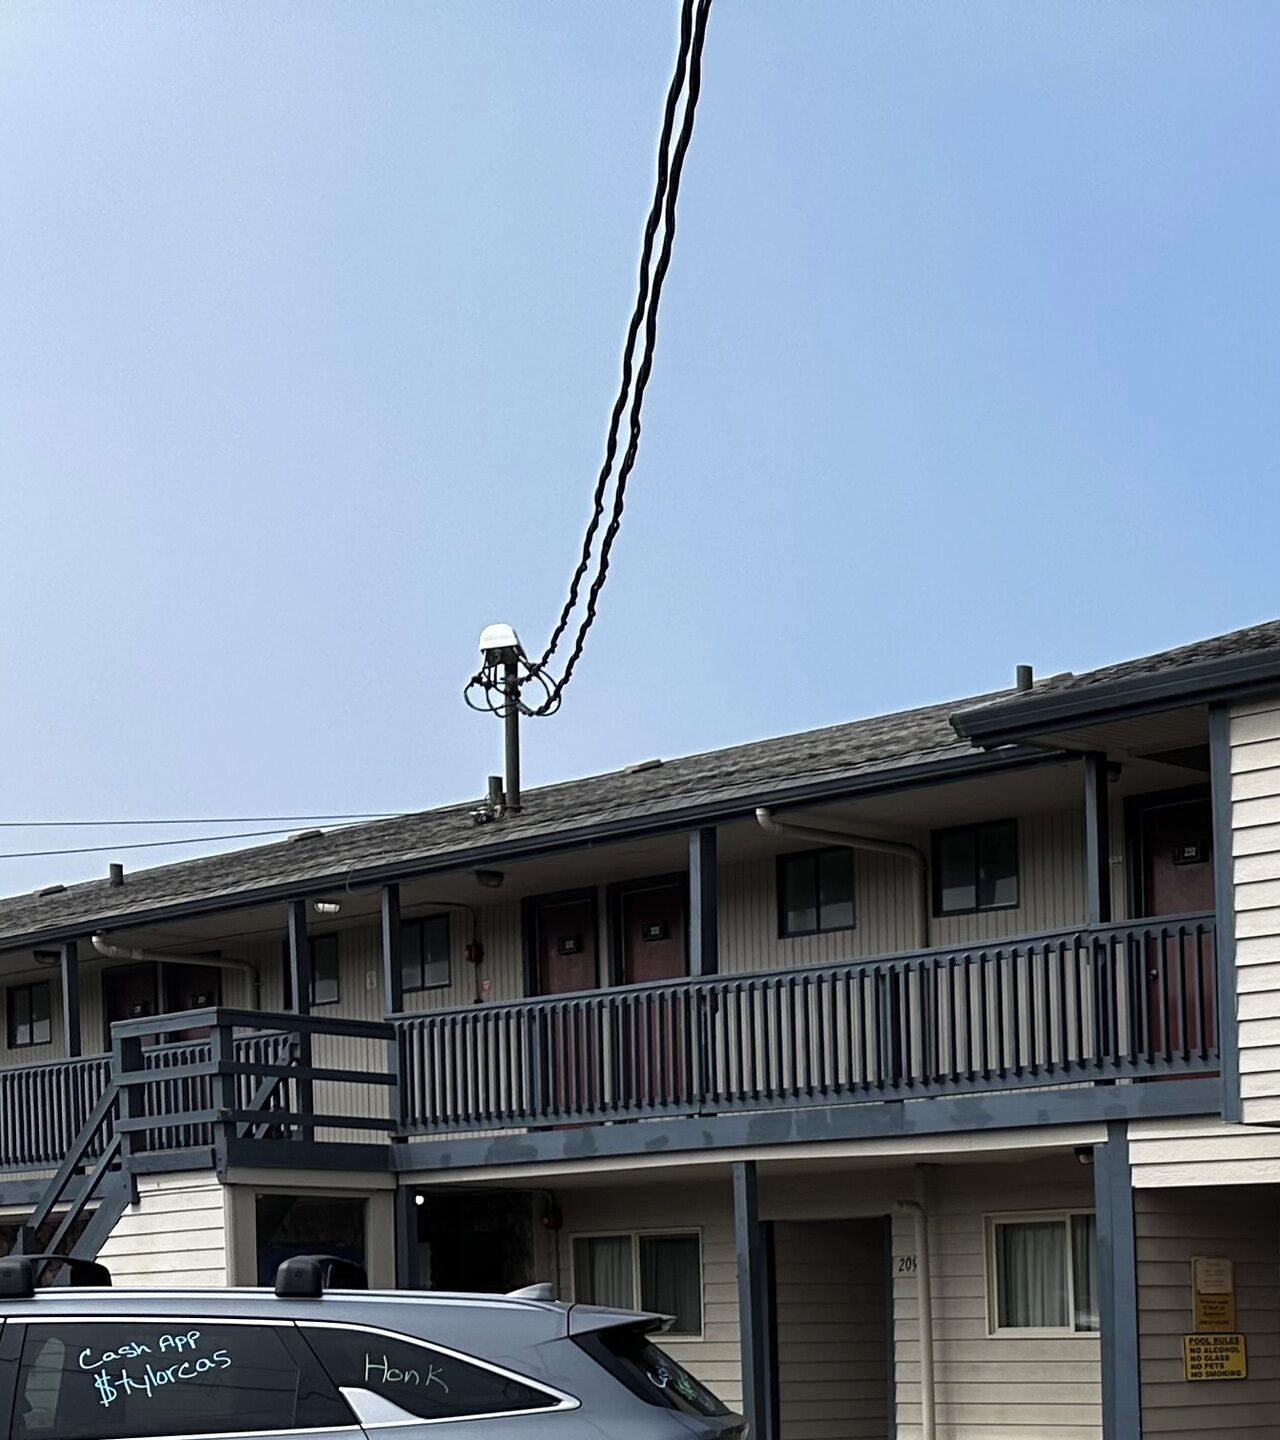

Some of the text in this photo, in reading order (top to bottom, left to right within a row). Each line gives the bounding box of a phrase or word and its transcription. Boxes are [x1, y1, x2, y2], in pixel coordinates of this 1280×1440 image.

[1188, 1337, 1210, 1345] POOL
[1203, 1346, 1241, 1354] ALCOHOL
[79, 1342, 152, 1370] Cash
[1203, 1354, 1230, 1362] GLASS
[1204, 1362, 1225, 1370] PETS
[1204, 1369, 1242, 1377] SMOKING
